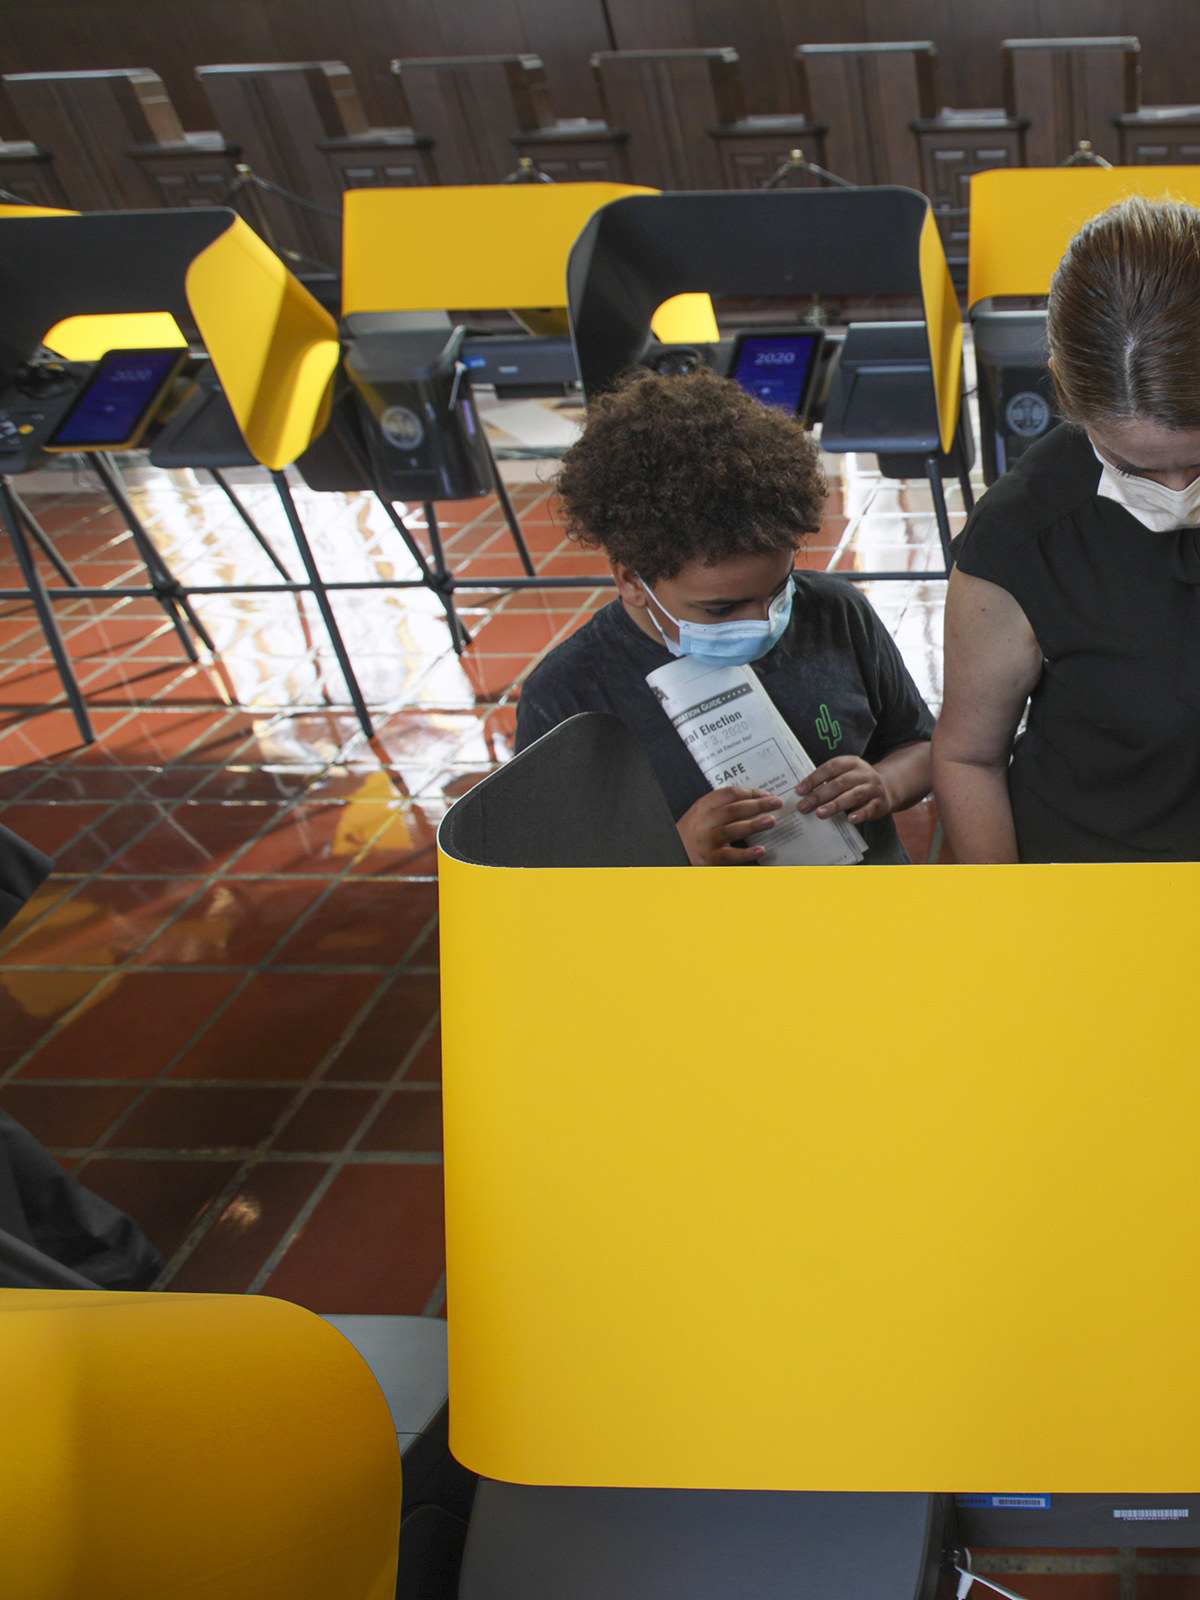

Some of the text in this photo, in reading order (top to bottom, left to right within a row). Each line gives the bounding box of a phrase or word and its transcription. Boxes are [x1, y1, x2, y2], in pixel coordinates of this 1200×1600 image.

[754, 351, 796, 367] 2020
[699, 711, 743, 736] Election
[722, 721, 750, 740] 2020
[715, 763, 747, 785] SAFE
